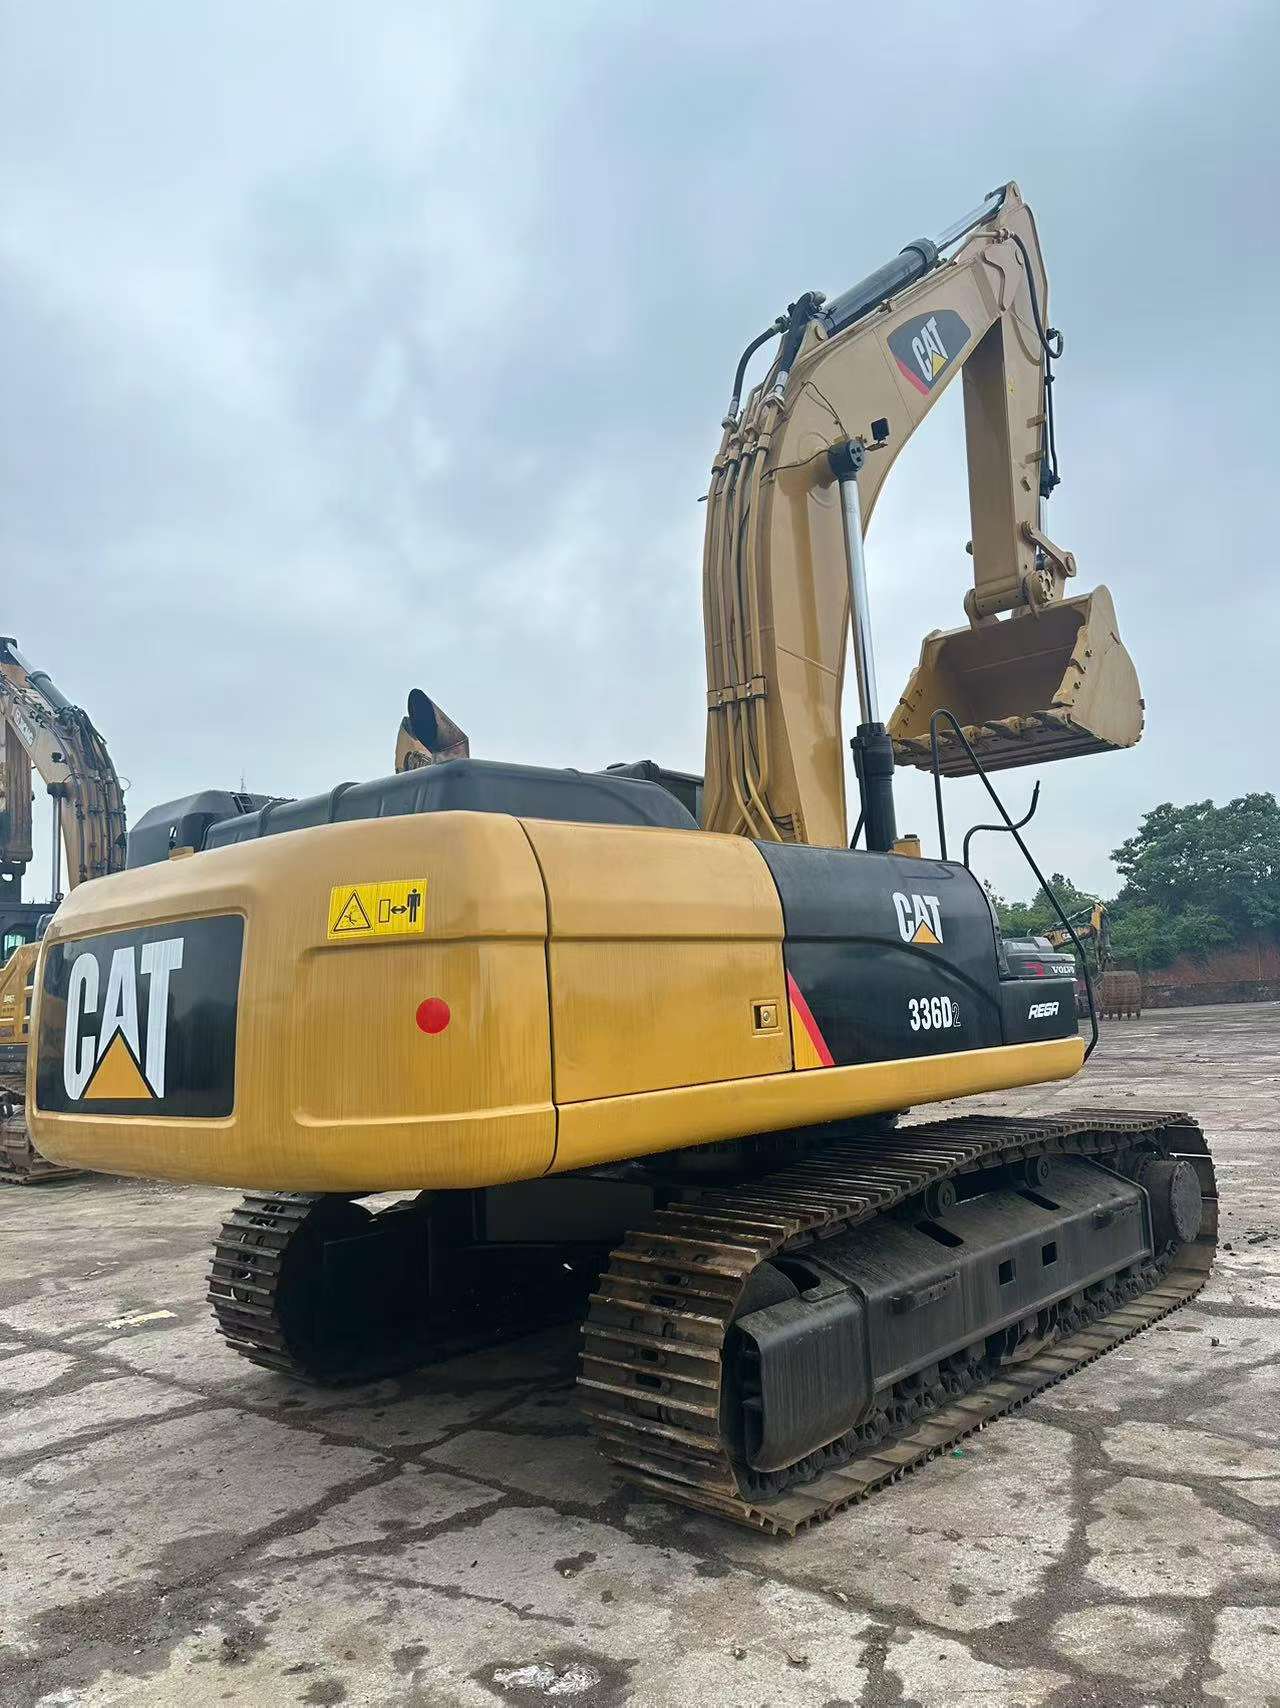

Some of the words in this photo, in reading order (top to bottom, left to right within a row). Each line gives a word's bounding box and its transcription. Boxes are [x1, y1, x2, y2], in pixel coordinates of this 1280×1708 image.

[911, 316, 949, 382] CAT
[892, 892, 944, 945] CAT
[63, 937, 185, 1101] CAT
